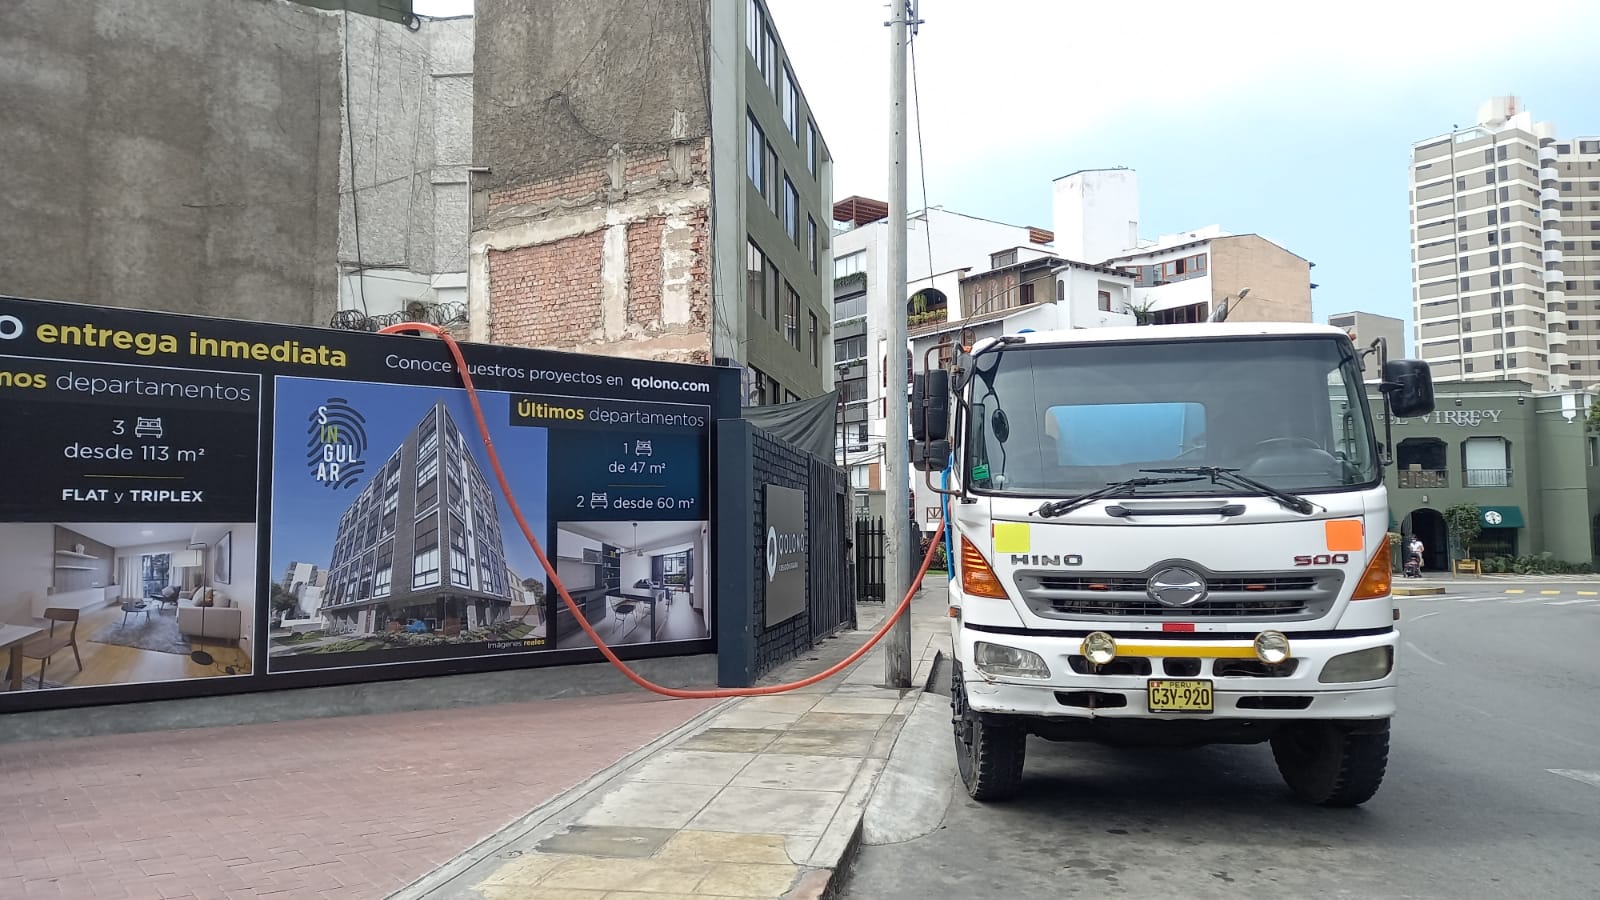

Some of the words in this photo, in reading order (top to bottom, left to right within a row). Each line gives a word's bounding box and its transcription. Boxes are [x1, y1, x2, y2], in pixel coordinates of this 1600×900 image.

[36, 323, 178, 356] entrega
[190, 331, 347, 367] inmediata
[385, 354, 452, 373] Conoce
[457, 363, 525, 379] uestros
[529, 368, 602, 385] proyectos
[606, 376, 623, 387] en
[631, 375, 710, 392] qolono.com
[56, 371, 251, 401] departamentos
[517, 398, 585, 420] Últimos
[589, 406, 705, 427] departamentos
[112, 420, 125, 435] 3
[64, 442, 133, 460] desde
[140, 445, 169, 461] 113
[177, 448, 205, 463] m²
[623, 442, 629, 455] 1
[608, 460, 625, 473] de
[629, 461, 645, 473] 47
[650, 462, 666, 474] m²
[62, 489, 108, 502] FLAT
[113, 492, 124, 504] y
[130, 489, 203, 503] TRIPLEX
[576, 495, 585, 508] 2
[613, 496, 653, 509] desde
[657, 497, 675, 509] 60
[678, 497, 695, 509] m²
[778, 533, 805, 556] QOLONO
[1011, 554, 1083, 566] HINO
[1293, 553, 1349, 566] 500
[1169, 681, 1192, 689] PERU
[1152, 688, 1210, 706] C3Y-920
